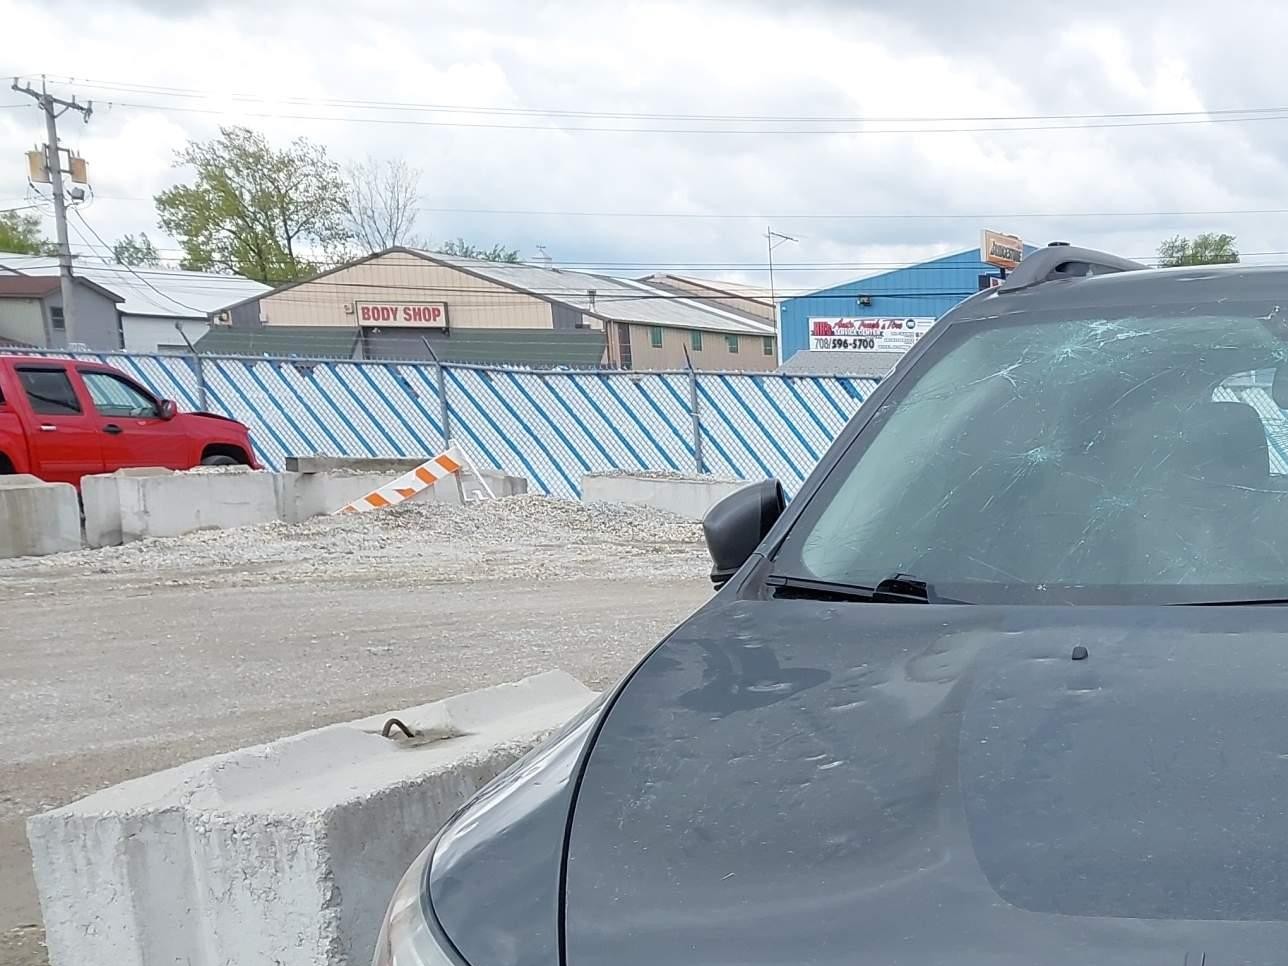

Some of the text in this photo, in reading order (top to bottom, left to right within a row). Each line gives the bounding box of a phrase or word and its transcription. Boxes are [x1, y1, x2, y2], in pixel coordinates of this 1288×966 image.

[361, 306, 441, 322] BODY SHOP
[815, 338, 875, 350] 708/596-5700
